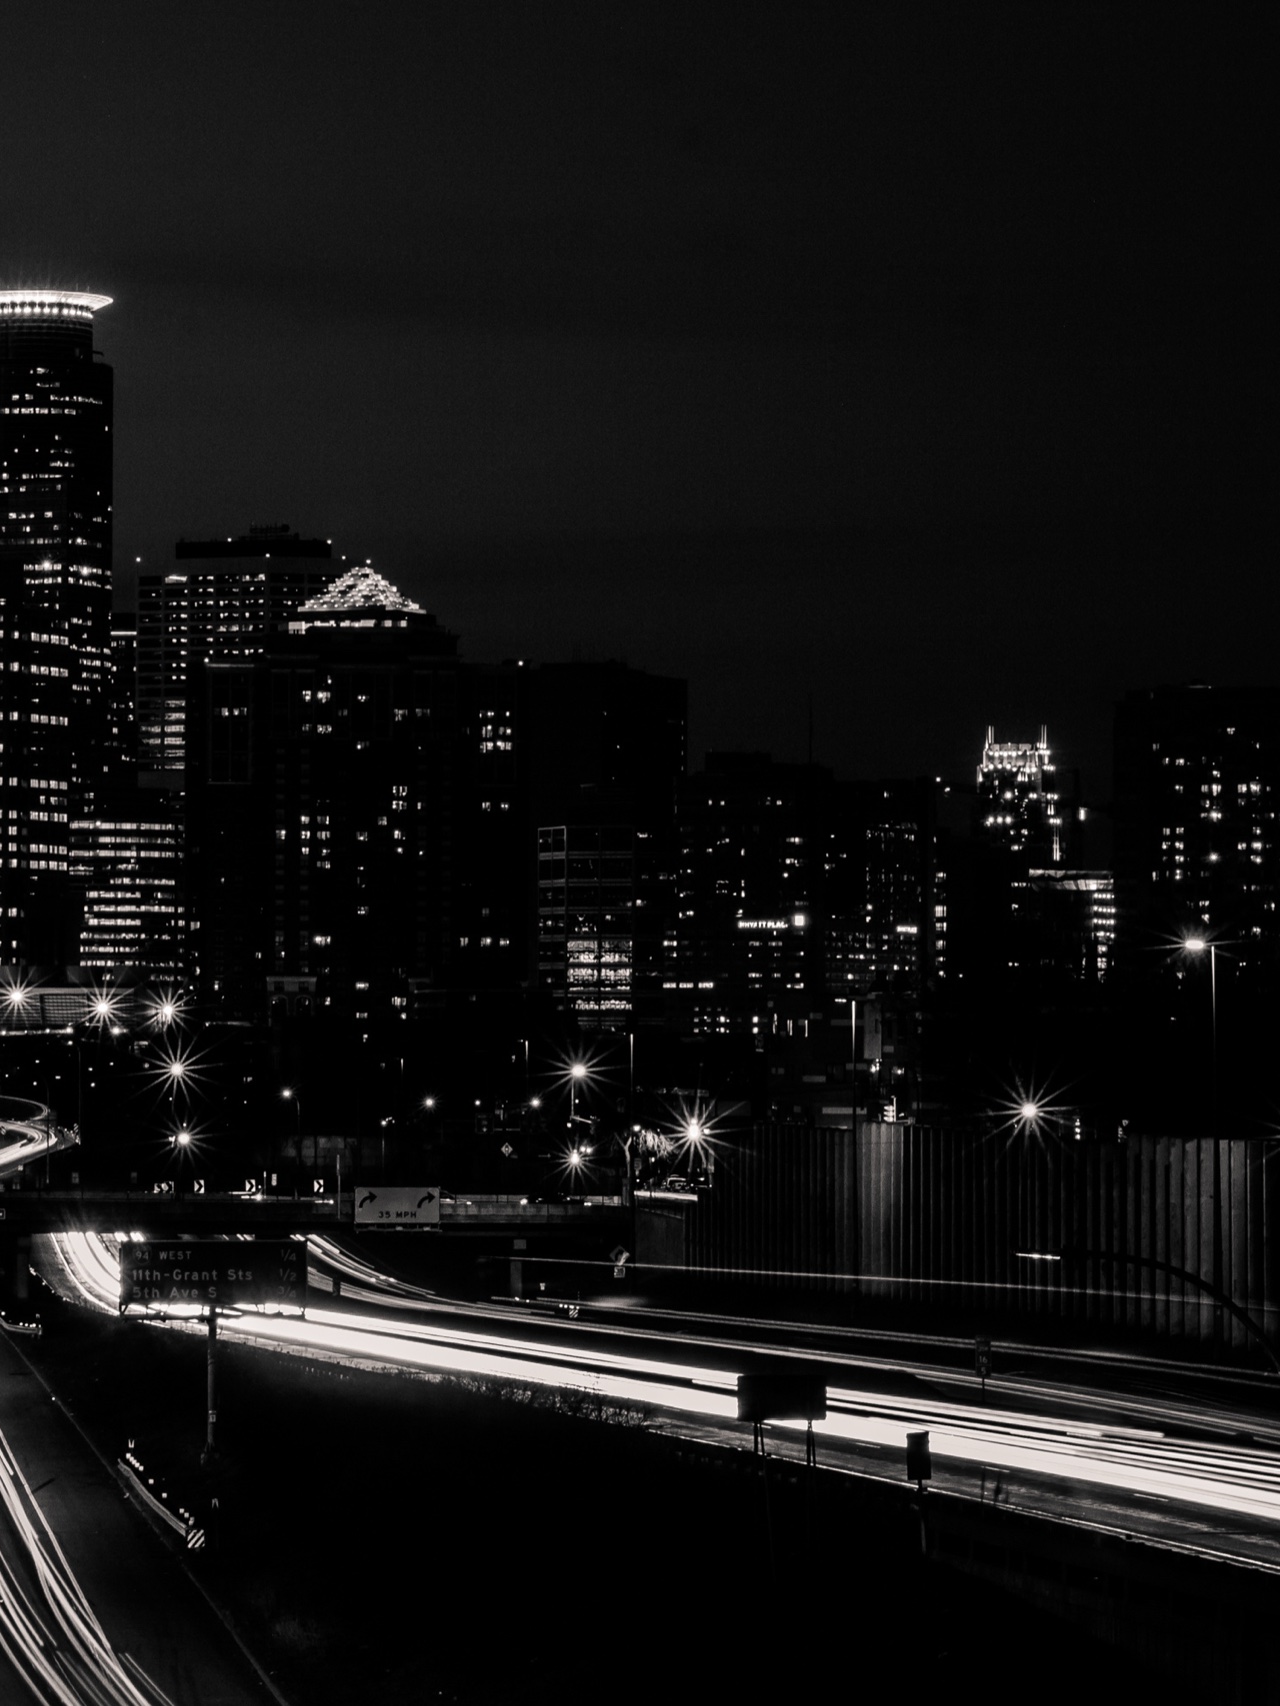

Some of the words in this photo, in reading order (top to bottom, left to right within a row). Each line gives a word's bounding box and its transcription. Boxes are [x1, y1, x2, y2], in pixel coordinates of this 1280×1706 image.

[378, 1211, 391, 1219] 35
[395, 1211, 417, 1219] MPH
[135, 1252, 149, 1260] 94
[159, 1251, 192, 1260] WEST
[132, 1269, 218, 1281] 11th-Grant
[227, 1269, 253, 1281] Sts
[132, 1286, 160, 1298] 5th
[170, 1286, 199, 1298] Ave
[208, 1286, 217, 1298] S
